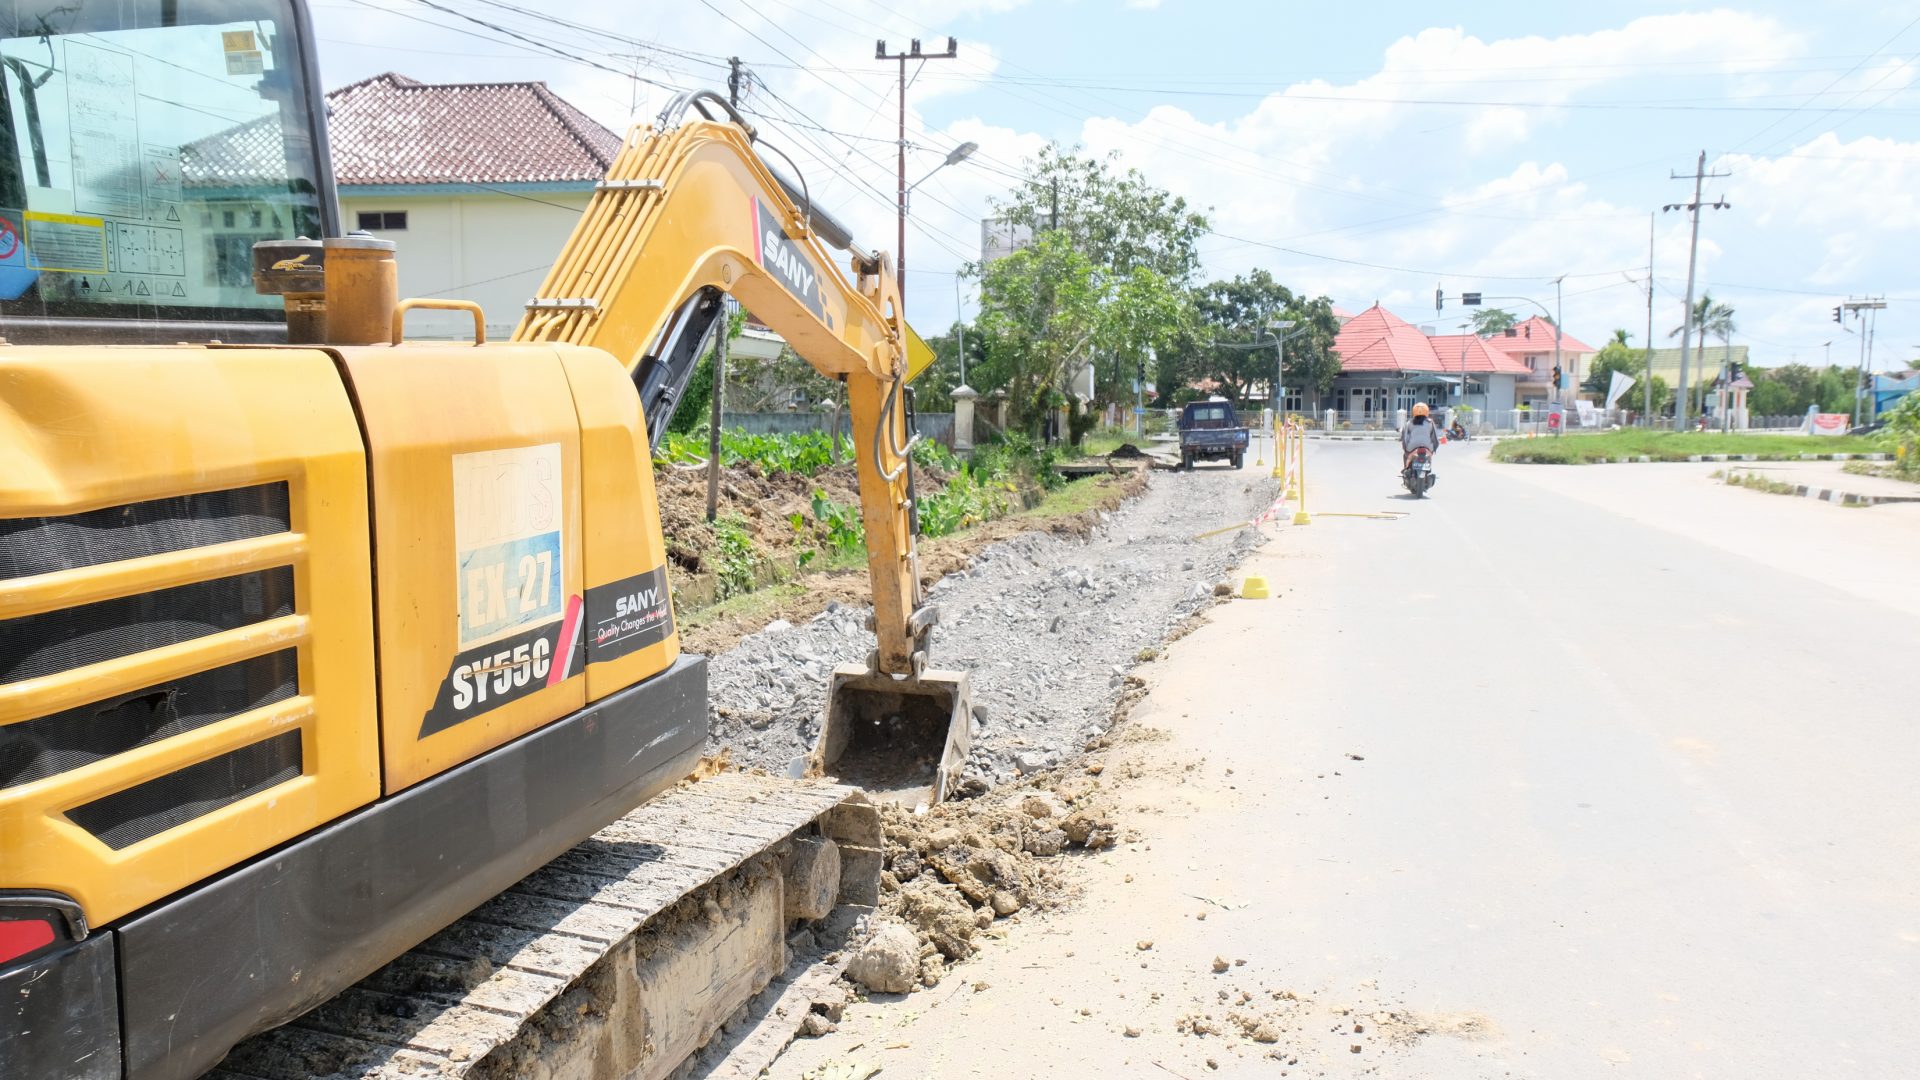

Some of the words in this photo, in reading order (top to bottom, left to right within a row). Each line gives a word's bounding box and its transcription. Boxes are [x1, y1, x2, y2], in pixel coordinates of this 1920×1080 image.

[764, 230, 814, 297] SANY
[467, 550, 552, 629] EX-27
[615, 586, 658, 619] SANY
[597, 623, 620, 640] Quality
[620, 617, 646, 632] Changes
[452, 637, 550, 710] SY55C
